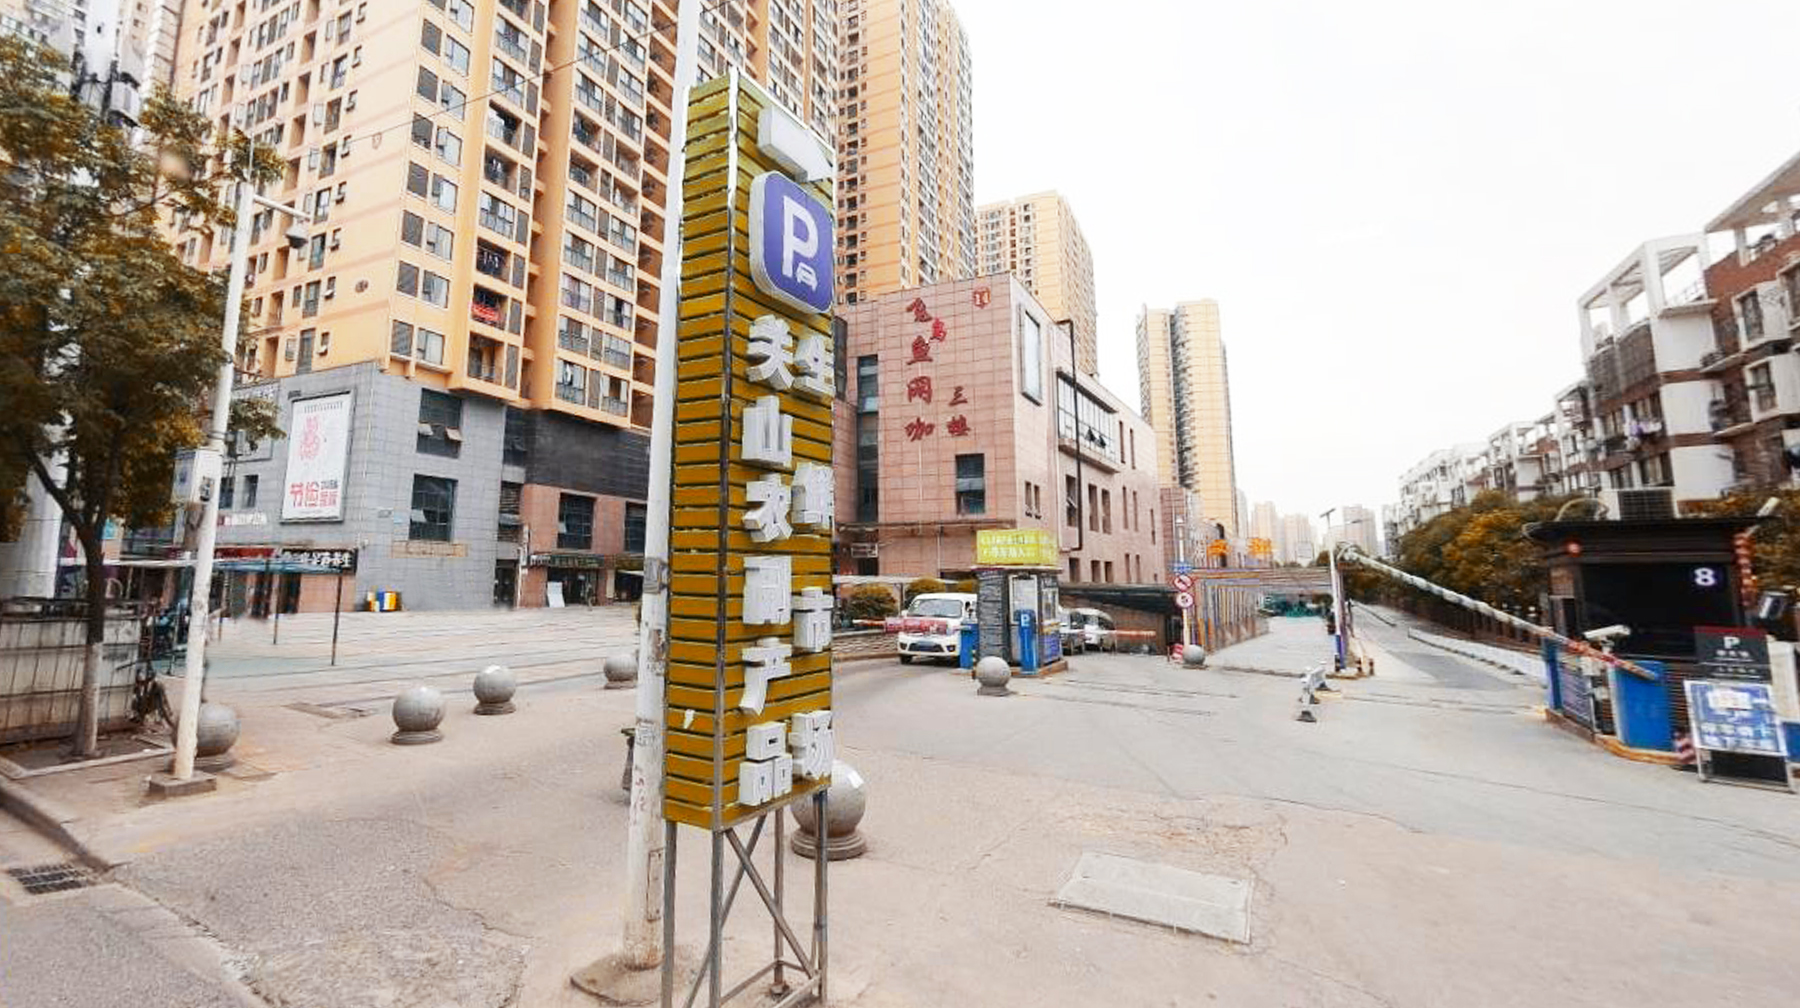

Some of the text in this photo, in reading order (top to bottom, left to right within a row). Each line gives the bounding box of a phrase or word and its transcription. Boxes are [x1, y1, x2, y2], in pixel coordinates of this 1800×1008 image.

[783, 195, 818, 277] P
[1695, 567, 1716, 586] 8
[1020, 613, 1030, 627] P
[1723, 636, 1741, 649] P
